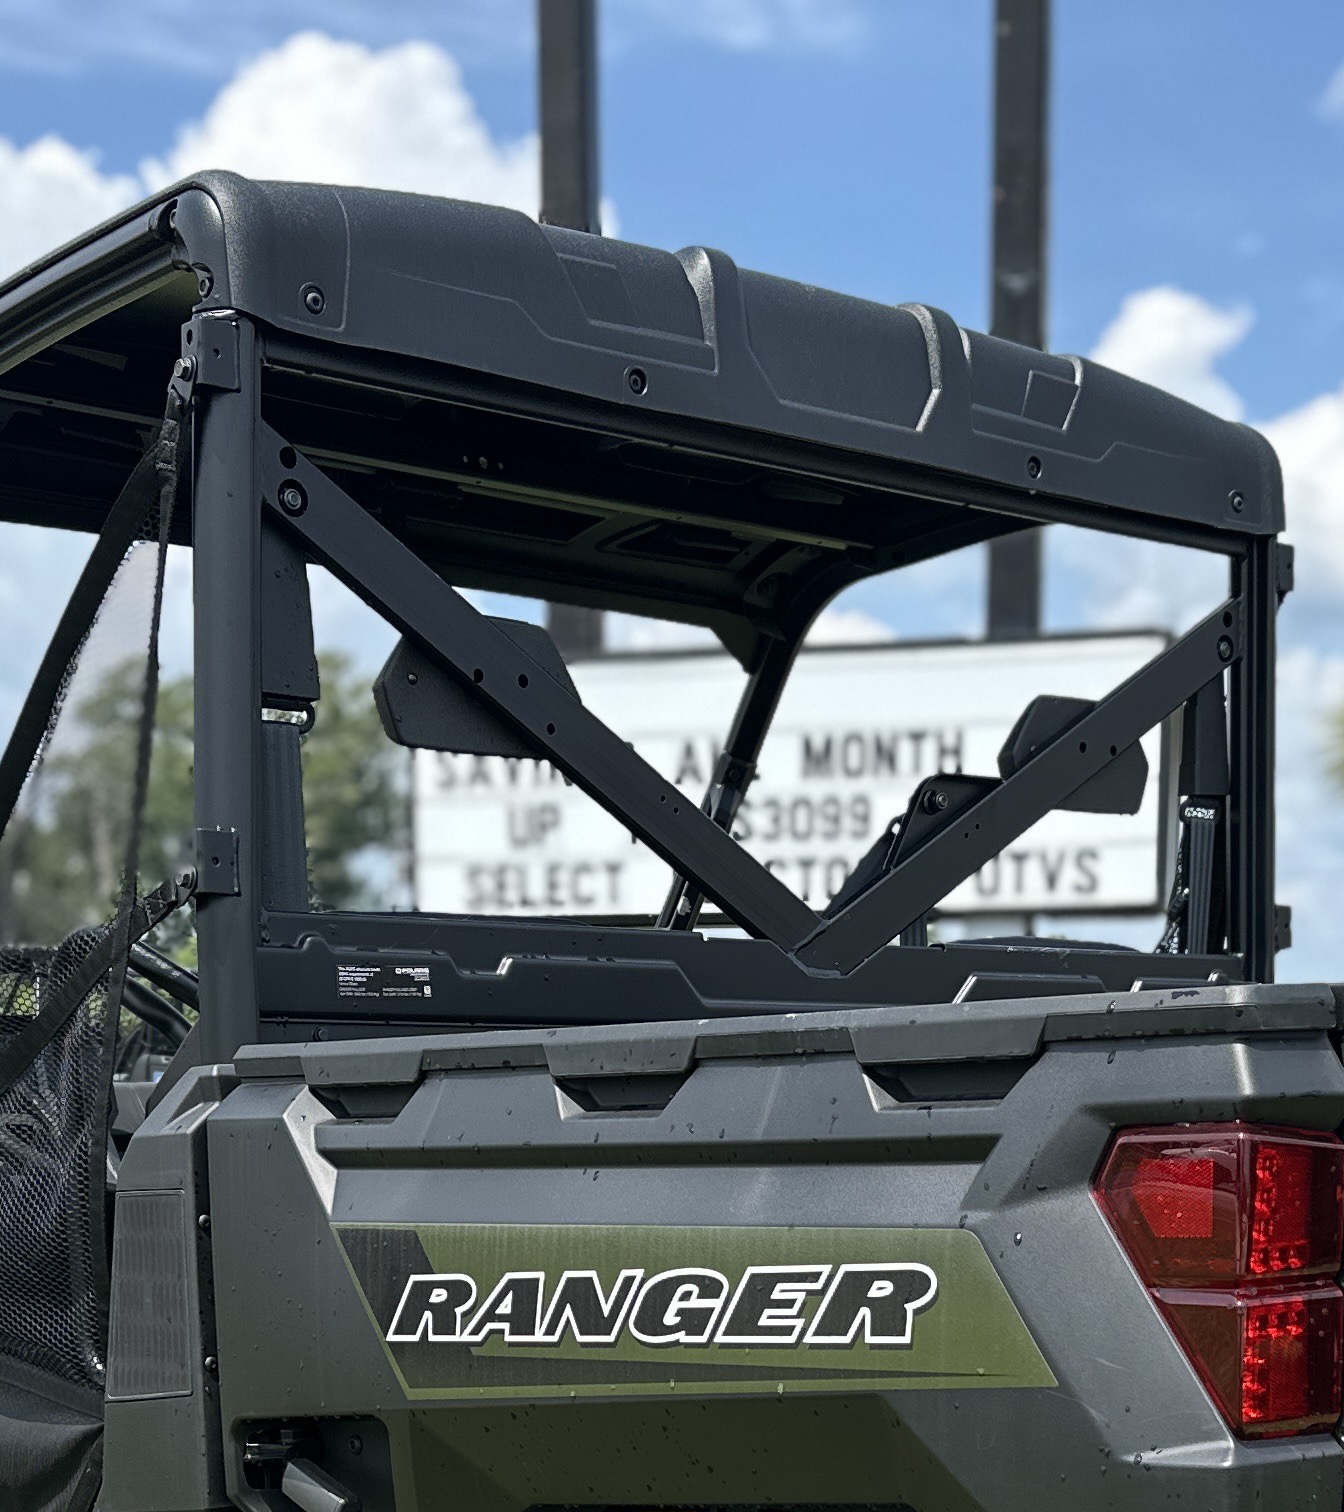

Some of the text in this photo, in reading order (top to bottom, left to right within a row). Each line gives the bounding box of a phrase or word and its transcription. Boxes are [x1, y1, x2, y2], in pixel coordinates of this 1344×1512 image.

[801, 731, 965, 778] MONTH
[508, 803, 560, 848] UP
[465, 862, 623, 908] SELECT
[975, 848, 1100, 896] UTVS
[385, 1262, 939, 1350] RANGER
